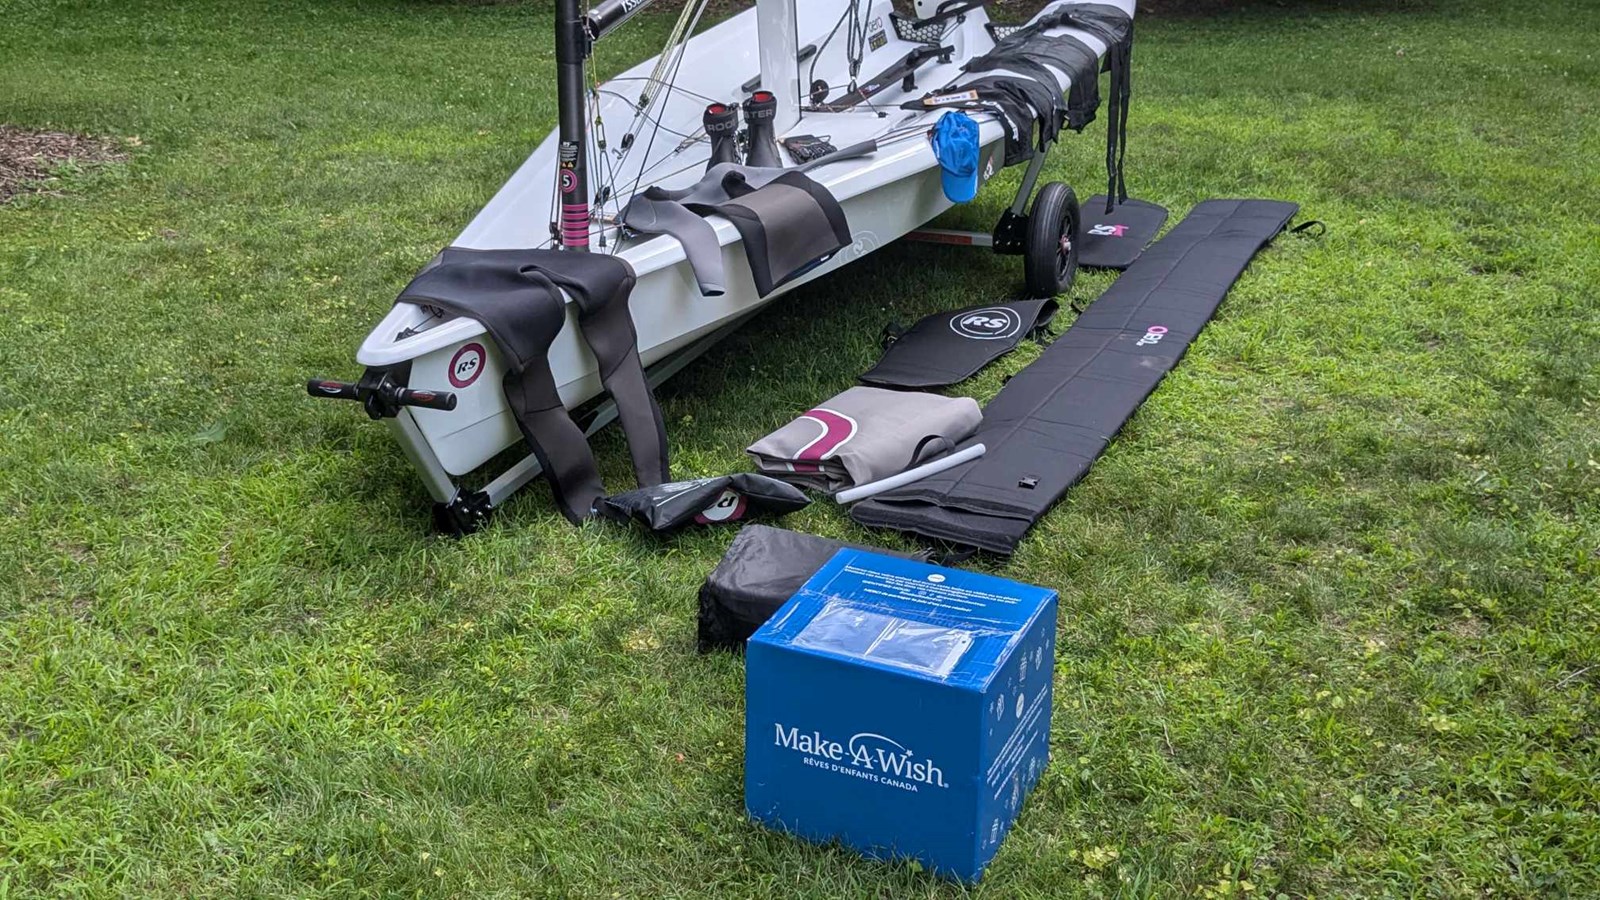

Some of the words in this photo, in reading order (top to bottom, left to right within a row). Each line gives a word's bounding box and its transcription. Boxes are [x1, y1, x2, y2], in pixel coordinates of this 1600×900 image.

[562, 174, 571, 187] 5
[963, 315, 1009, 329] RS
[456, 357, 478, 375] RS
[803, 756, 829, 770] RÊVES
[831, 764, 879, 783] D'ENFANTS
[880, 776, 918, 792] CANADA
